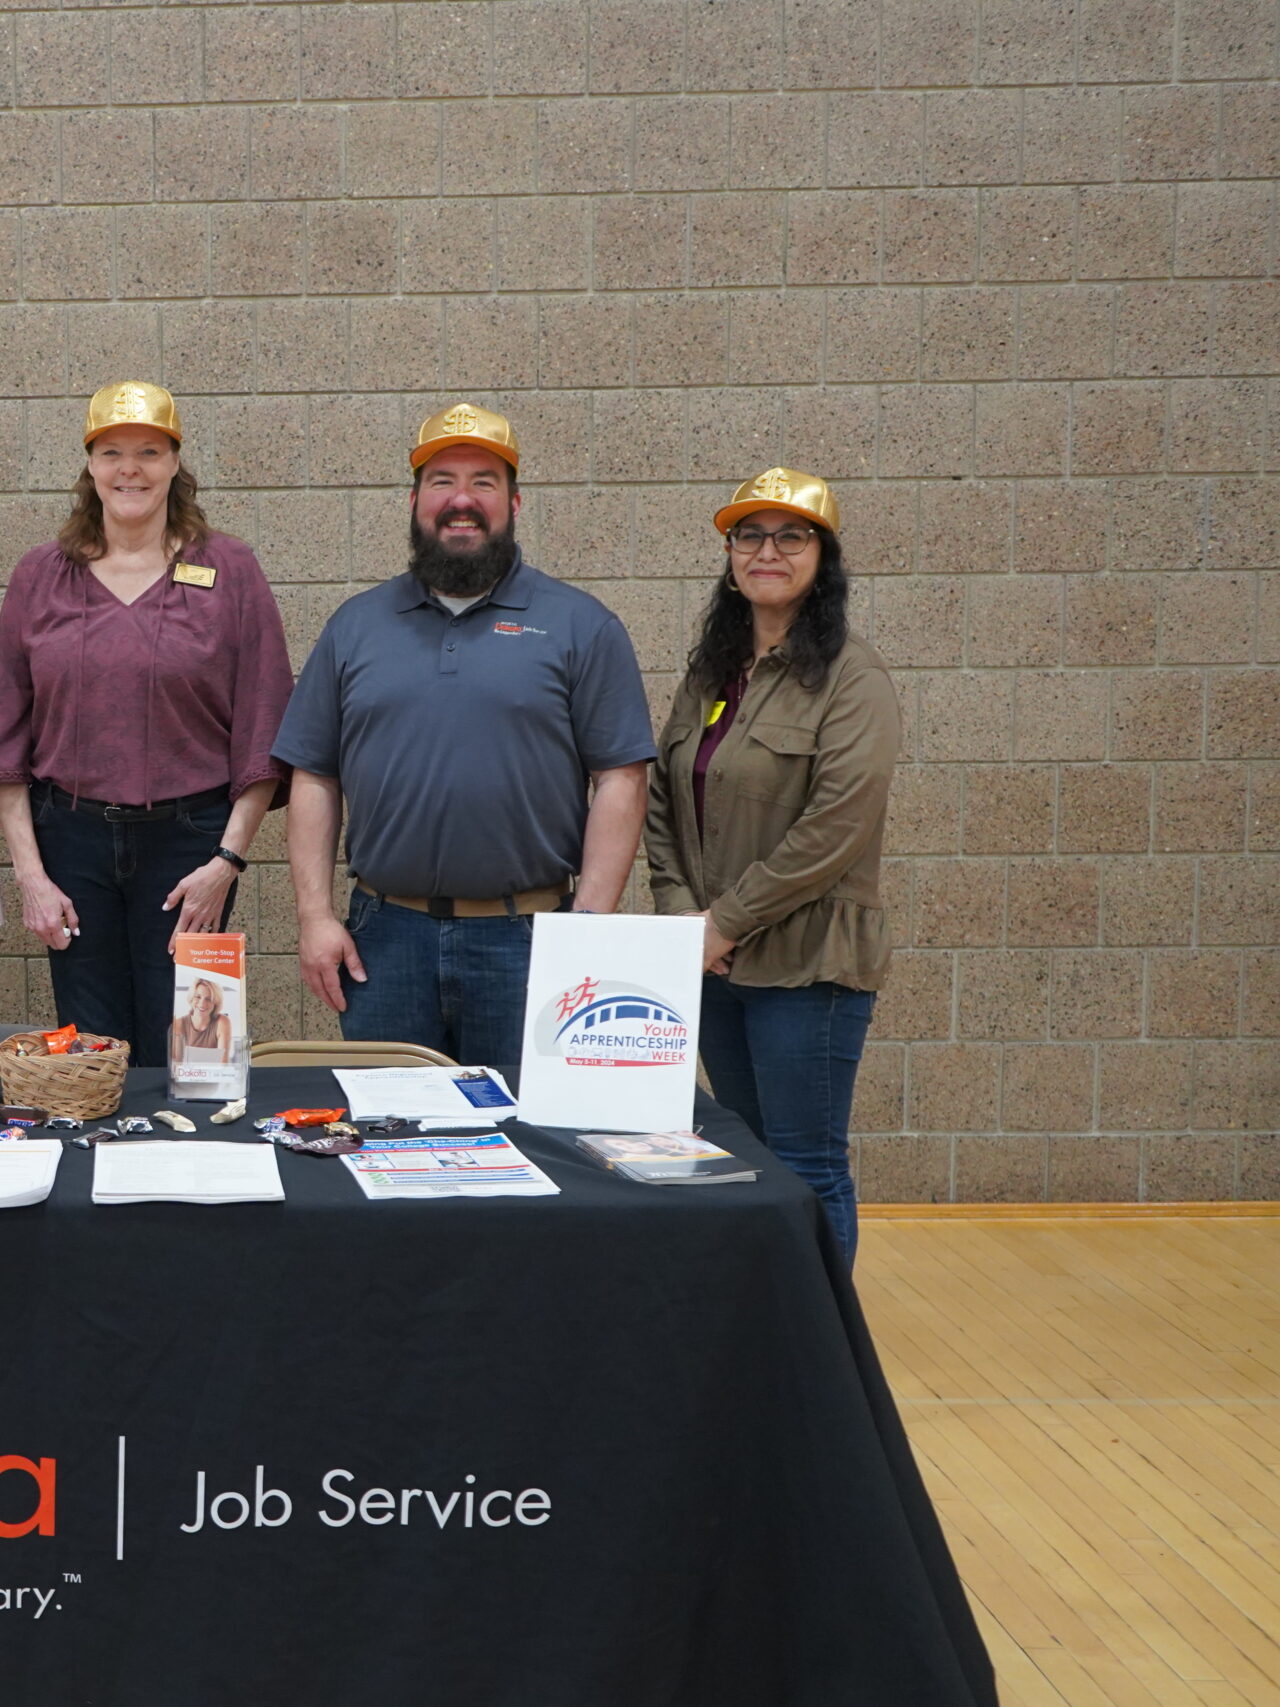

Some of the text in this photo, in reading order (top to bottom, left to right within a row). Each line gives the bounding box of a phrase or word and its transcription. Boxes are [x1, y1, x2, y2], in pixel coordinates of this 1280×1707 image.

[205, 949, 235, 957] One-Stop
[643, 1023, 687, 1037] Youth
[570, 1034, 687, 1049] APPRENTICESHIP
[651, 1051, 686, 1062] WEEK
[178, 1066, 207, 1078] Dakota
[180, 1465, 552, 1533] Job Service
